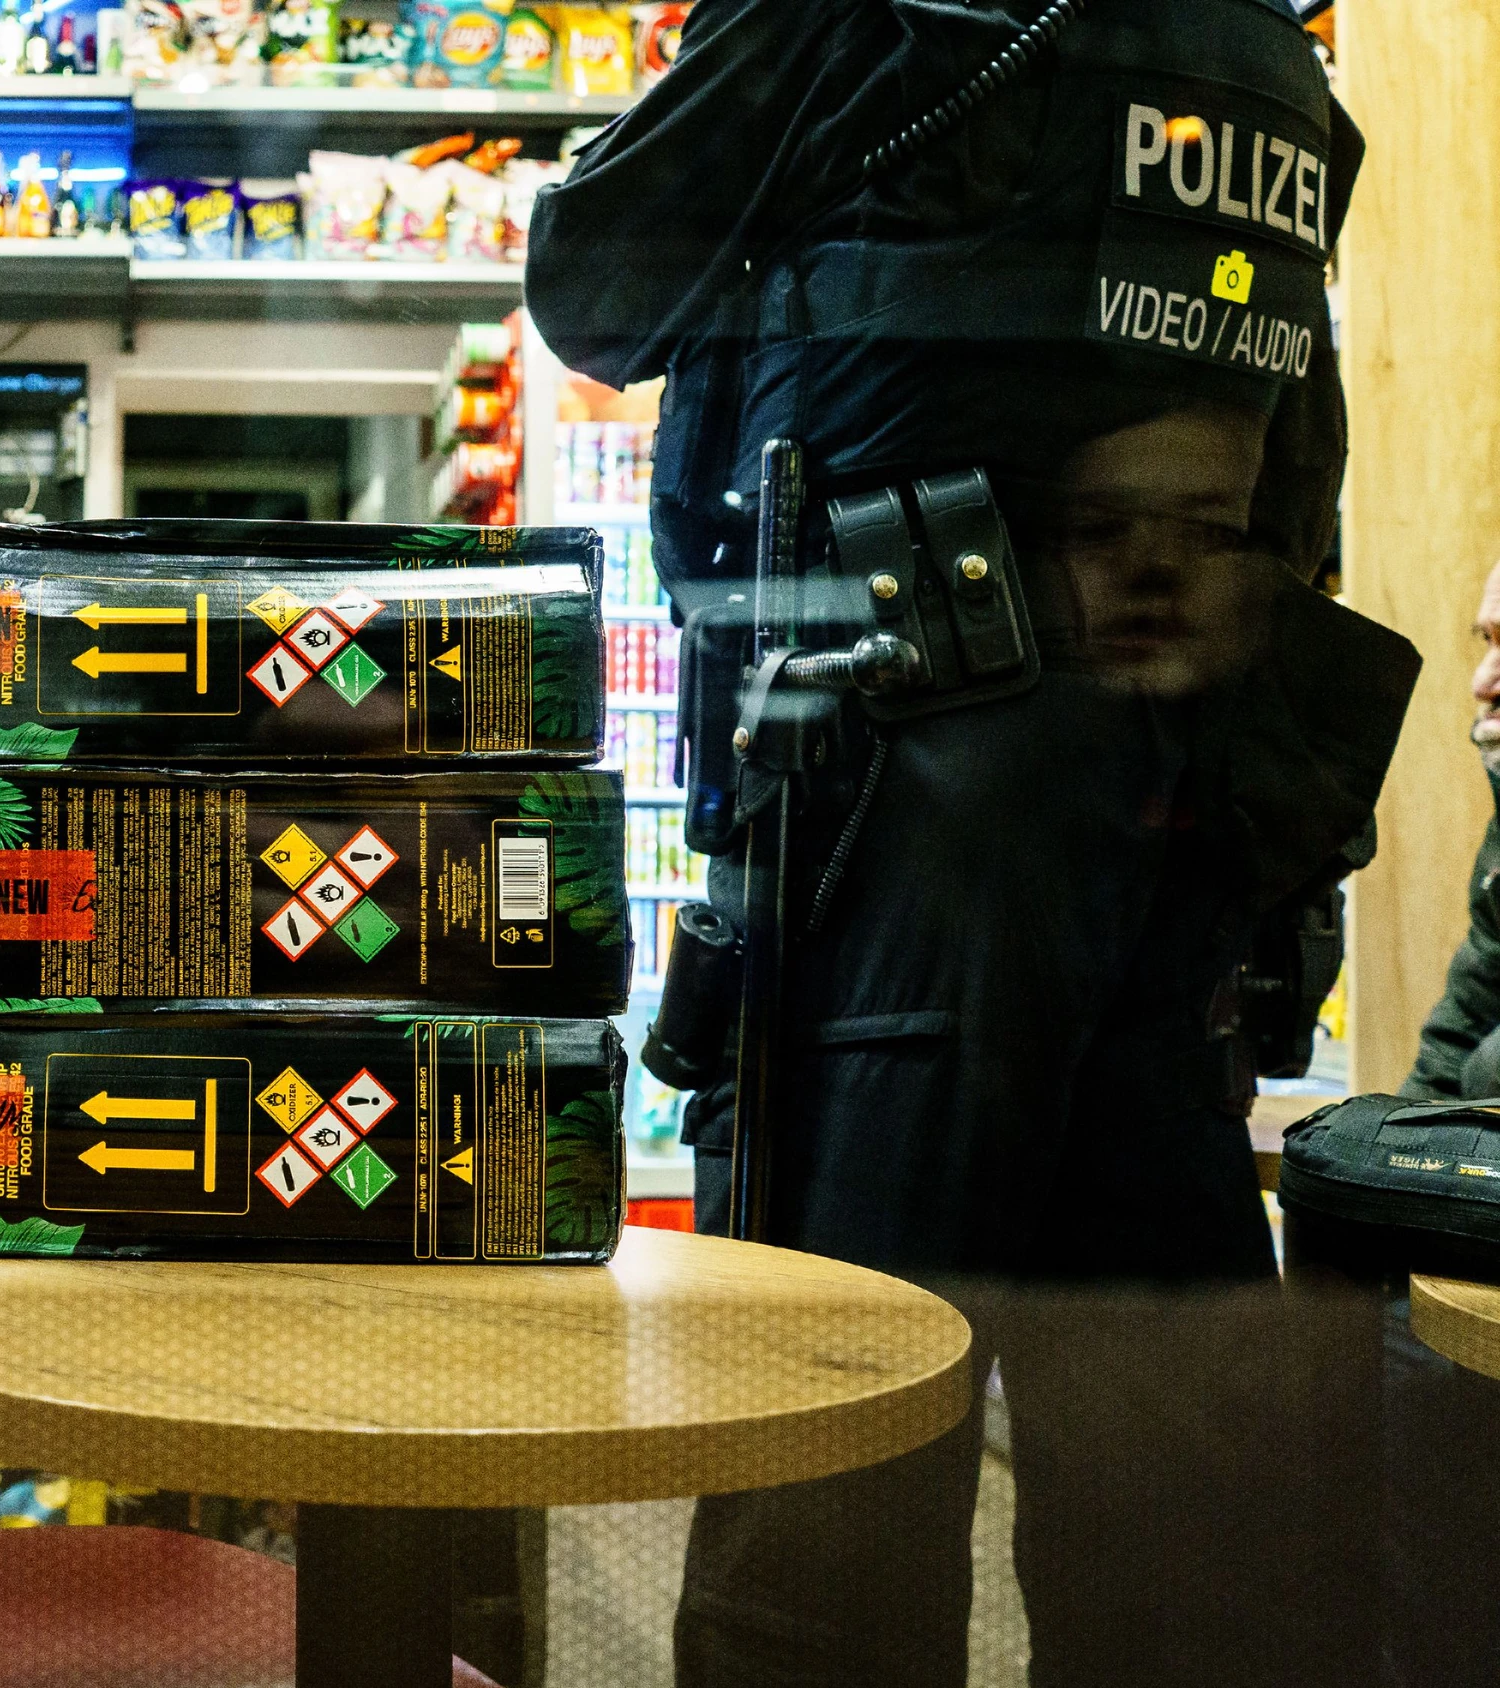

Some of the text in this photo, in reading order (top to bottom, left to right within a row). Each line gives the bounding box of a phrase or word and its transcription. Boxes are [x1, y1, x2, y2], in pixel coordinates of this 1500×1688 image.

[1125, 103, 1327, 251] POLIZEI
[1100, 276, 1312, 379] VIDEO / AUDIO
[14, 643, 27, 682] FOOD
[408, 638, 417, 663] CLASS
[408, 671, 417, 688] 1070
[308, 850, 317, 863] 5.1
[420, 840, 428, 869] NITROUS
[420, 870, 428, 887] WITH
[288, 1082, 297, 1123] OXIDIZER
[305, 1094, 313, 1106] 5.1
[20, 1086, 34, 1176] FOOD GRADE
[453, 1094, 462, 1145] WARNING!
[420, 1139, 428, 1165] CLASS
[6, 1138, 19, 1199] NITROUS
[383, 1172, 391, 1180] 2
[420, 1173, 428, 1191] 1070
